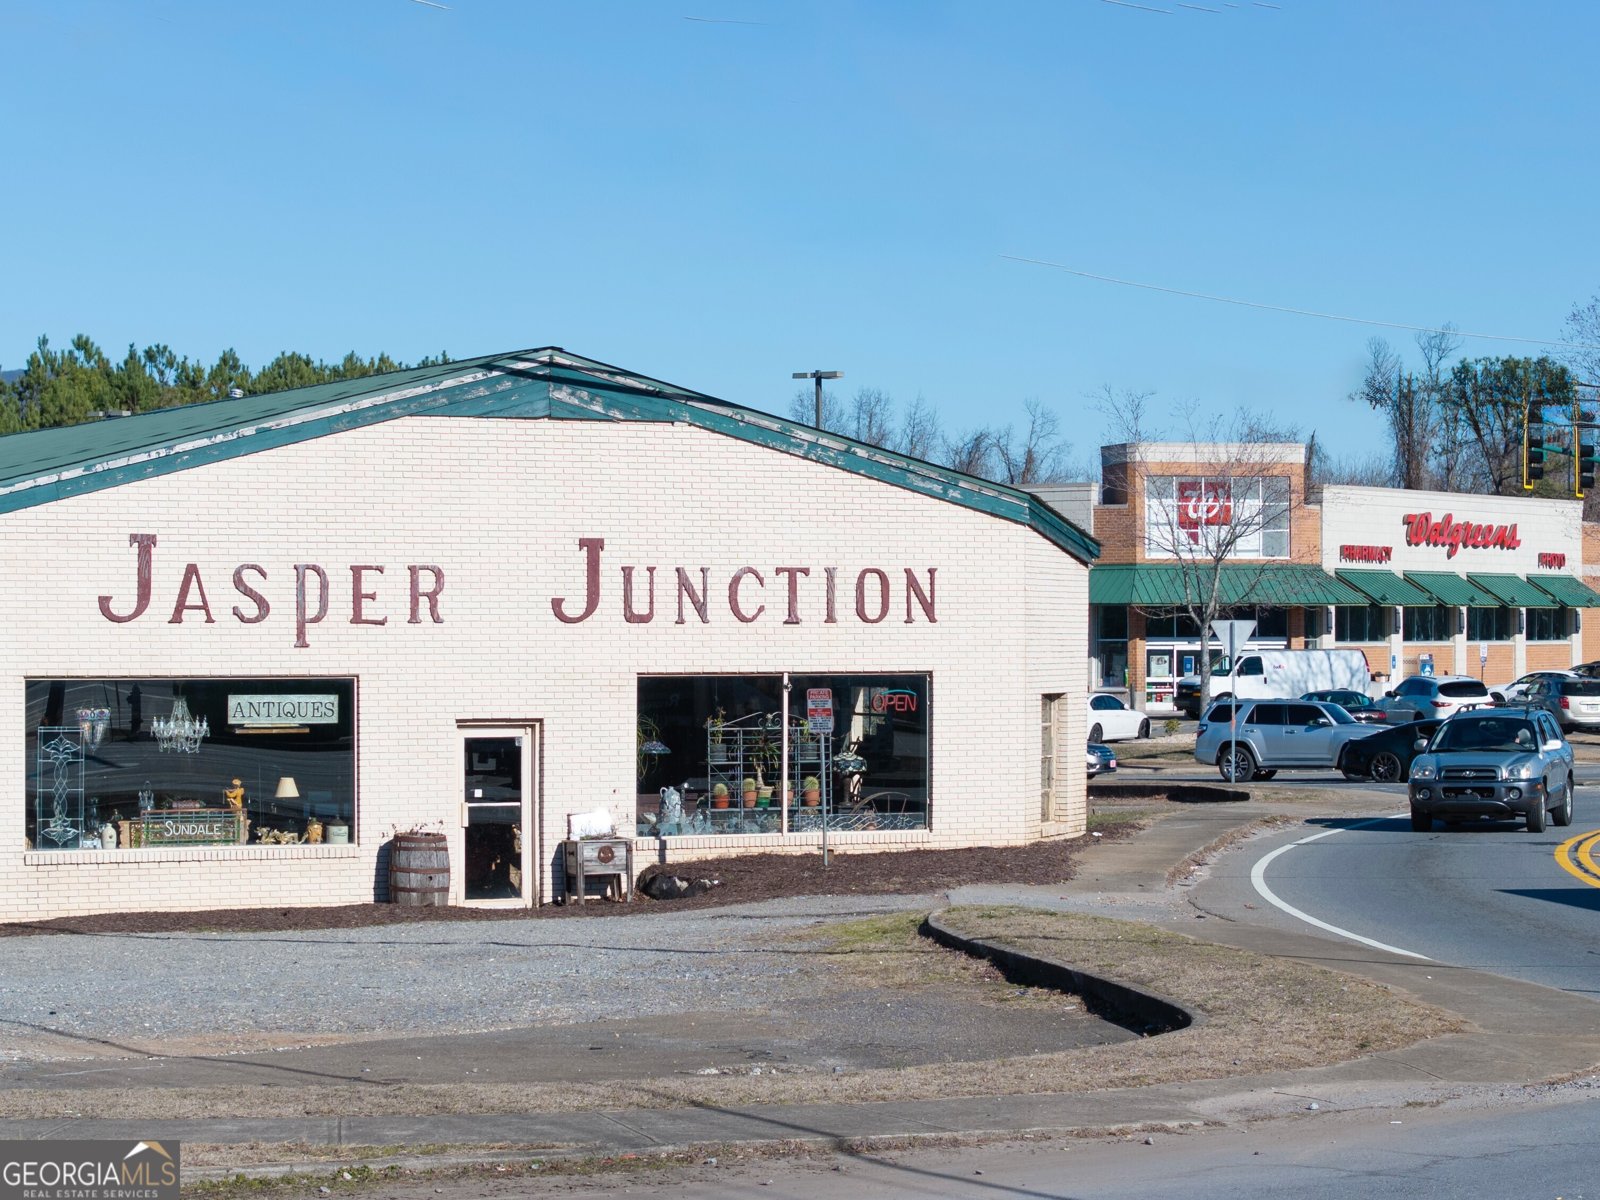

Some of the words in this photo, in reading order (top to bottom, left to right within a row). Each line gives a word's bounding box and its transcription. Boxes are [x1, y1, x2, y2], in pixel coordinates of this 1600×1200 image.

[1403, 512, 1521, 560] Walgreens
[1340, 545, 1393, 563] PHARMACY
[1538, 552, 1566, 569] PHOTO
[98, 534, 445, 648] JASPER
[551, 538, 938, 624] JUNCTION
[232, 701, 335, 719] ANTIQUES
[872, 694, 917, 711] OPEN
[164, 820, 221, 837] SUNDALE
